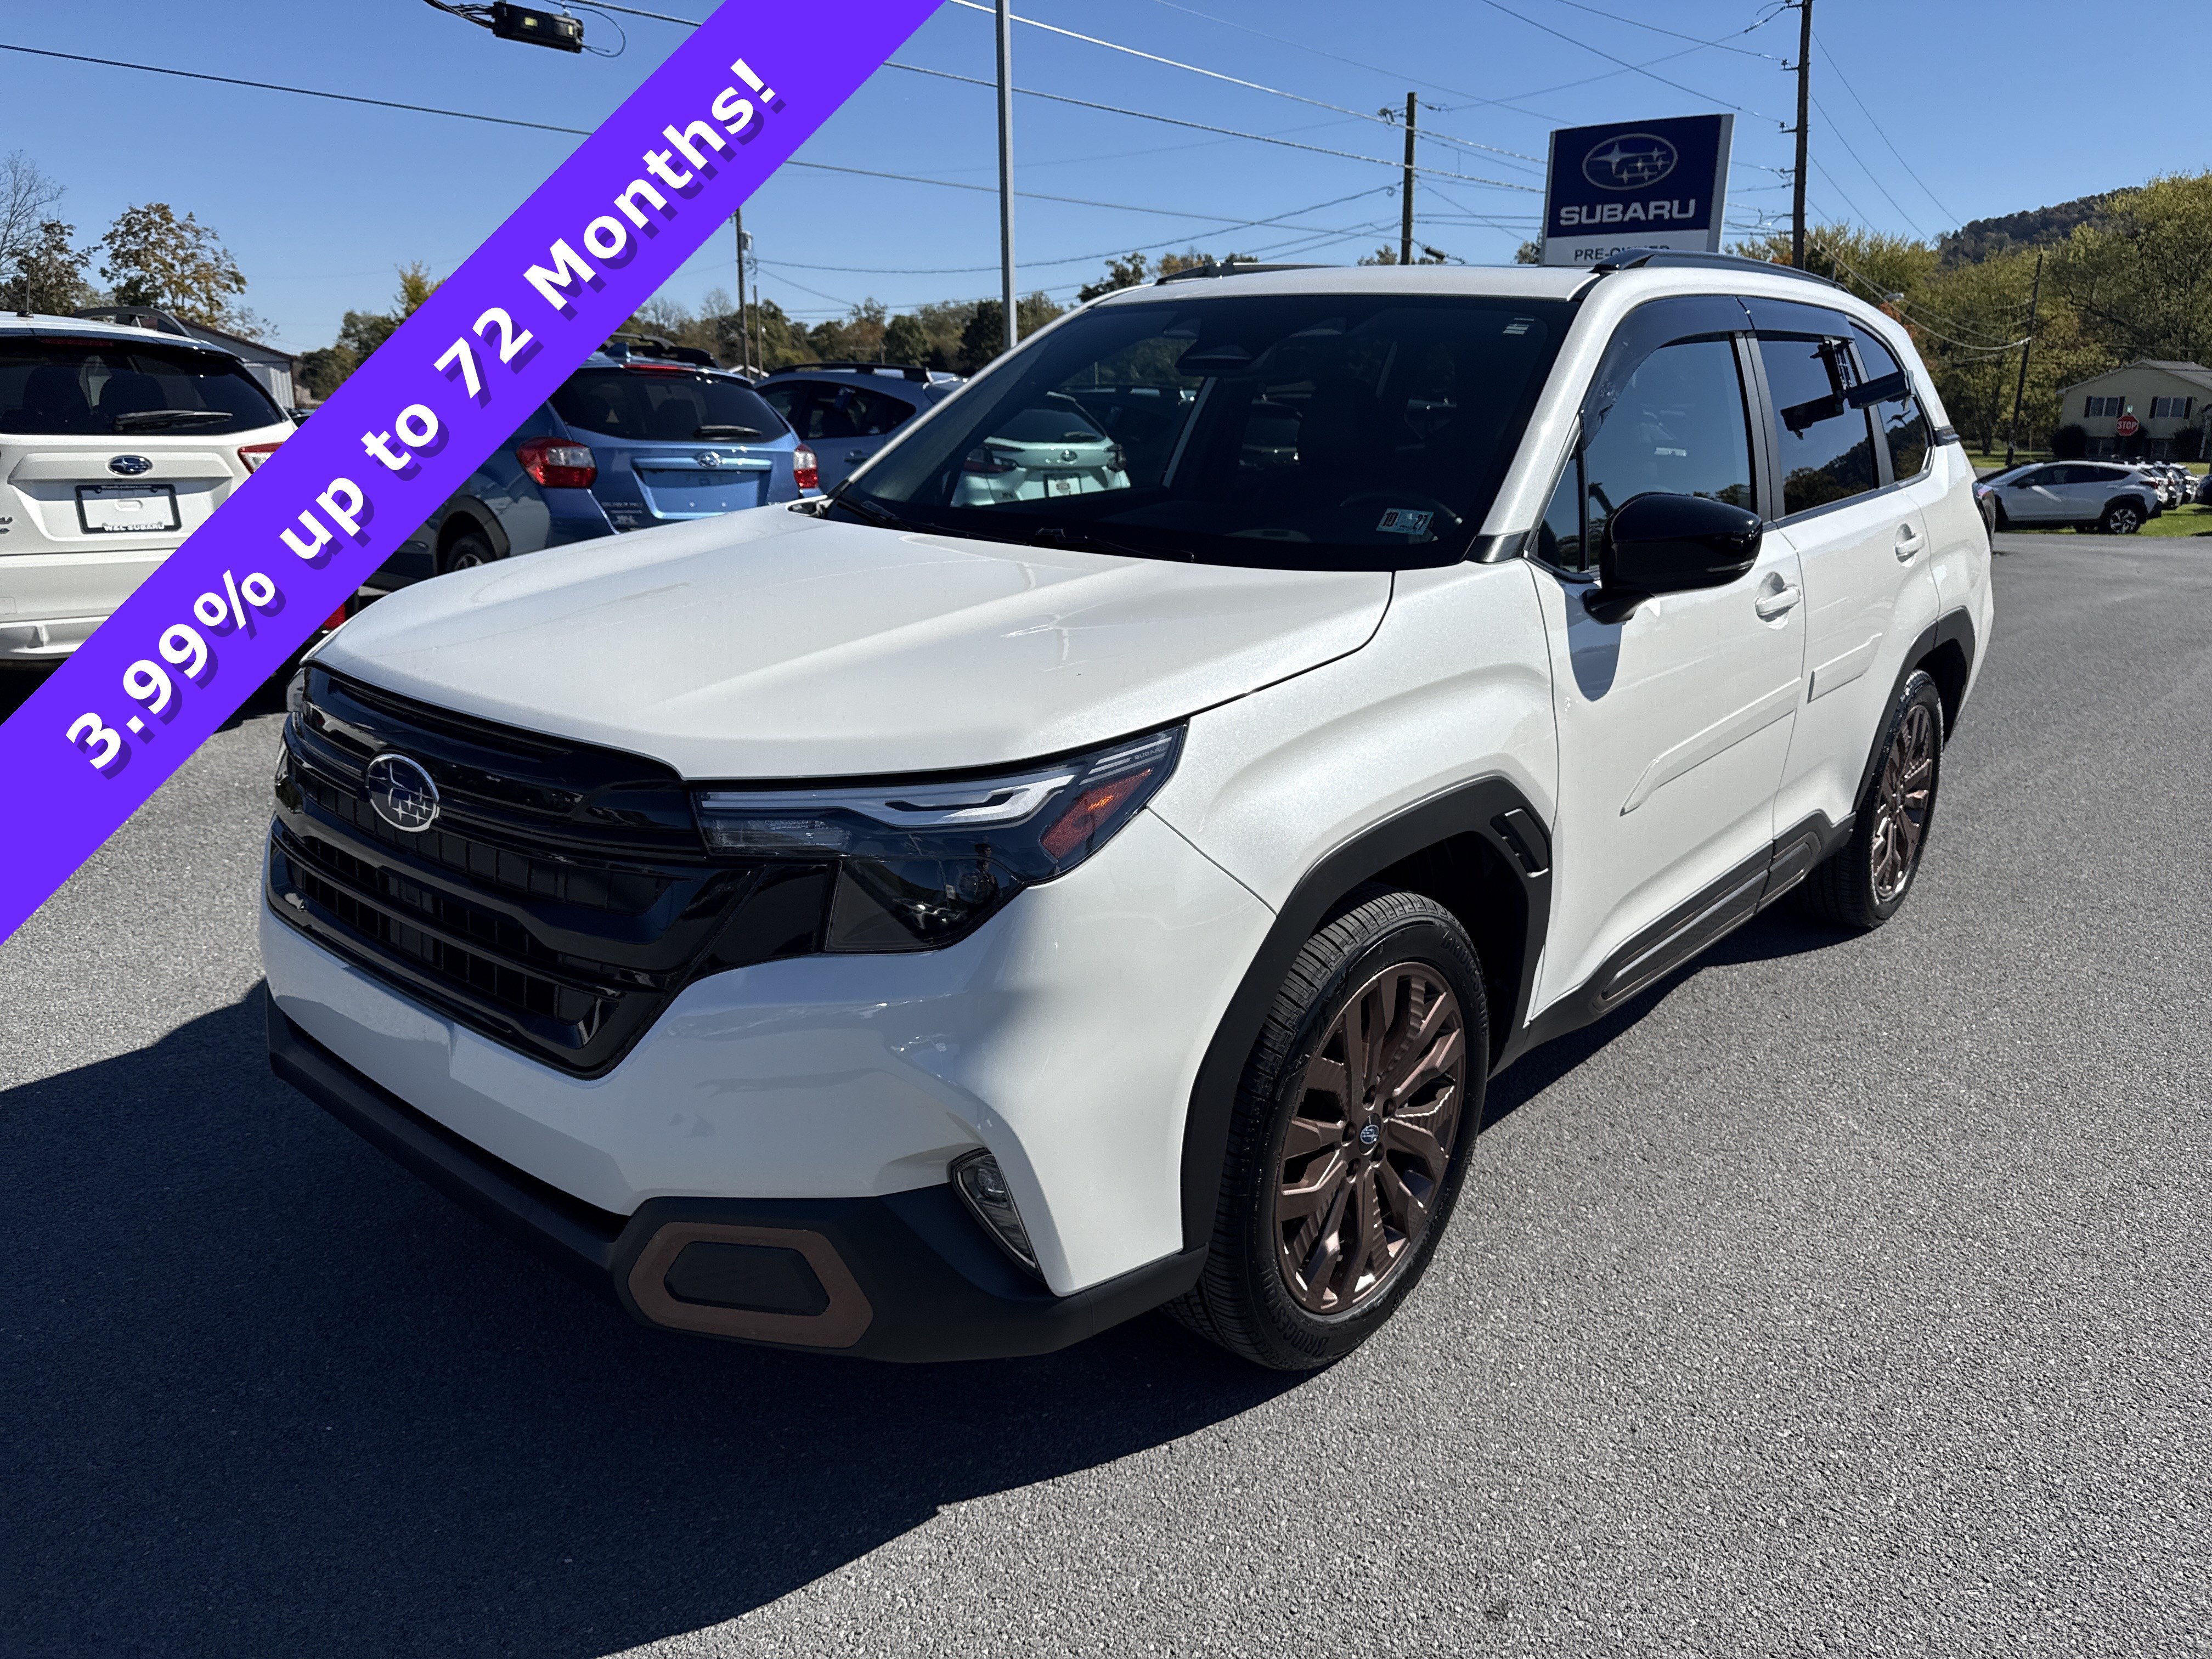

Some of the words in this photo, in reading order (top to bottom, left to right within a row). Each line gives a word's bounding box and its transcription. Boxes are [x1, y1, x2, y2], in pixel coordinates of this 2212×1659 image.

[1559, 199, 1696, 226] SUBARU
[1575, 245, 1669, 261] PRE-O
[2117, 421, 2137, 430] STOP
[1383, 511, 1399, 527] 10
[1412, 514, 1429, 531] 27
[1134, 747, 1165, 760] SUBARU
[1258, 1256, 1330, 1358] BRIDGESTONE
